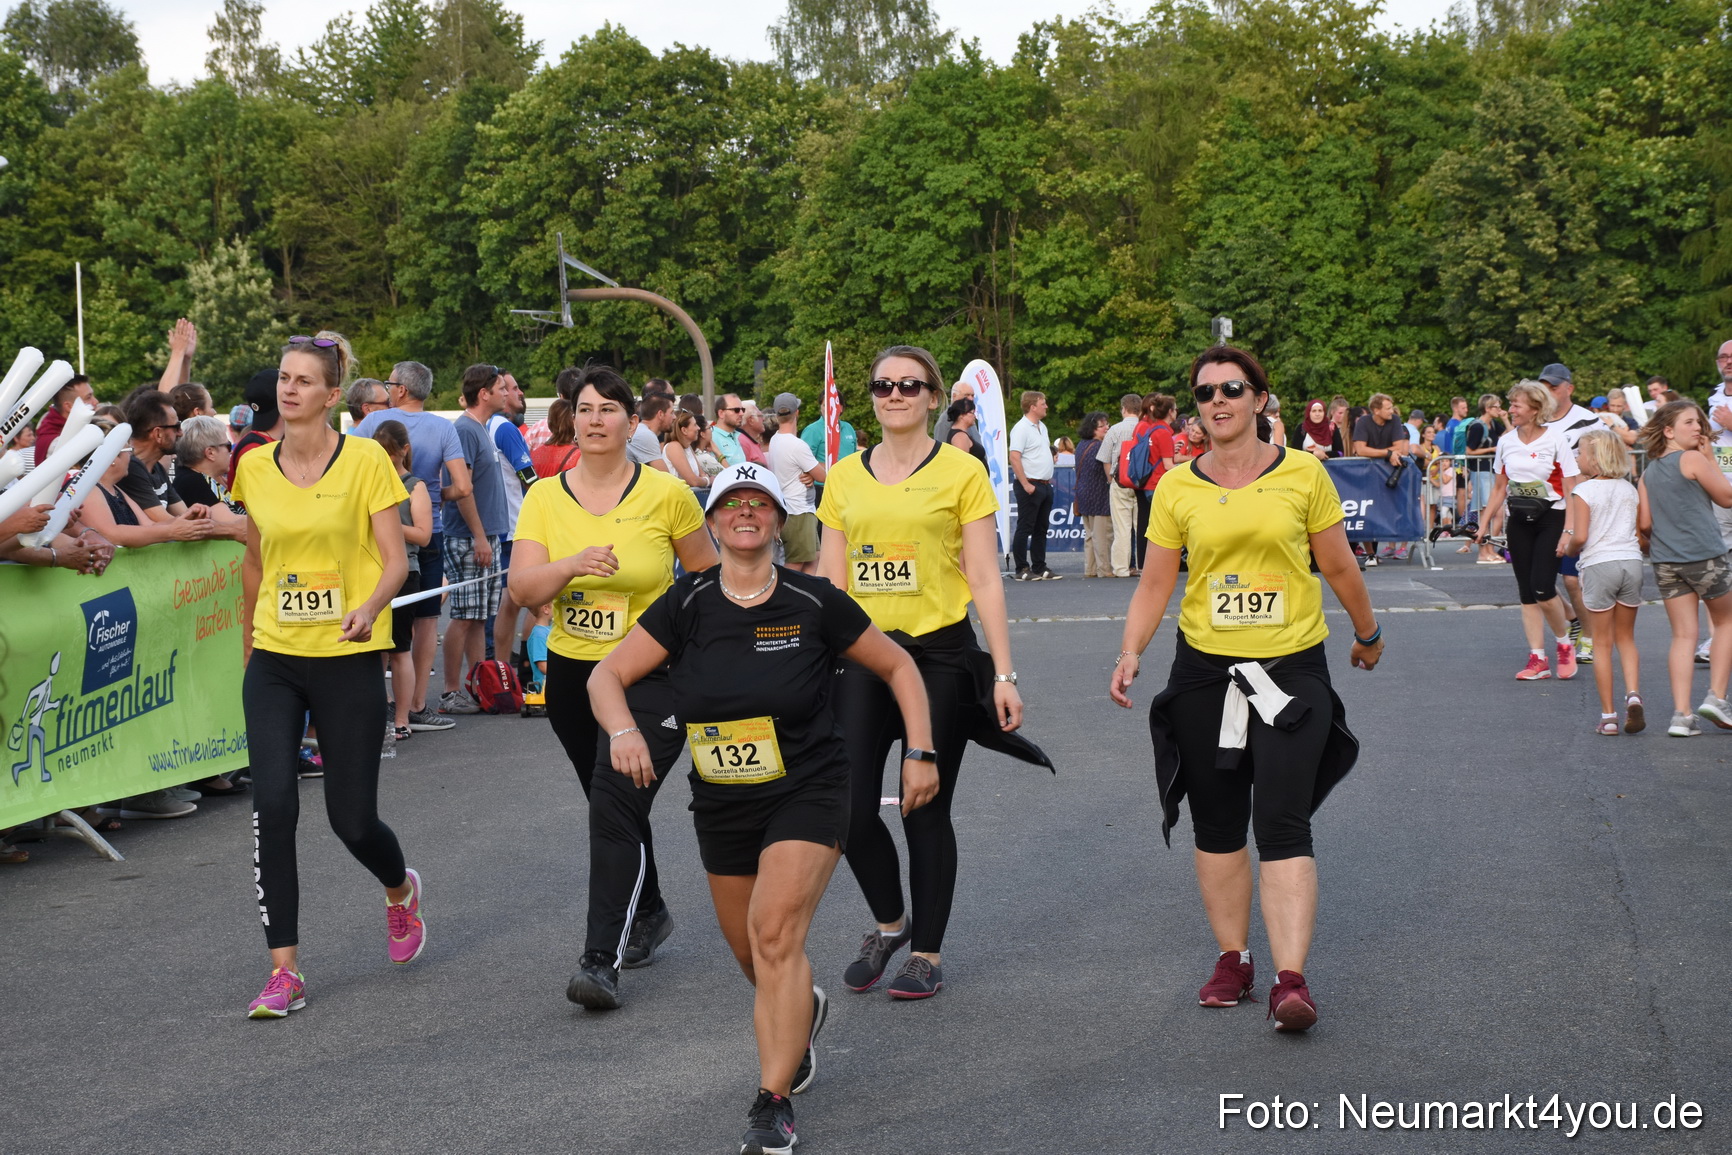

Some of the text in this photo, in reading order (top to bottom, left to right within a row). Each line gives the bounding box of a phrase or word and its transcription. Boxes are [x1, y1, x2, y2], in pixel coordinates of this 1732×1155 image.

[736, 466, 757, 480] NY
[1517, 487, 1538, 496] 359
[857, 561, 911, 581] 2184
[173, 559, 227, 610] Gesunde
[282, 589, 332, 611] 2191
[1217, 592, 1278, 614] 2197
[195, 600, 233, 642] laufen
[566, 607, 615, 631] 2201
[96, 620, 131, 645] Fischer
[756, 643, 800, 652] INNENARCHITEKTEN
[55, 648, 178, 750] firmenlauf
[661, 721, 679, 730] adidas
[58, 732, 114, 773] neumarkt
[711, 742, 760, 767] 132
[712, 765, 767, 775] Gorzella Manuela
